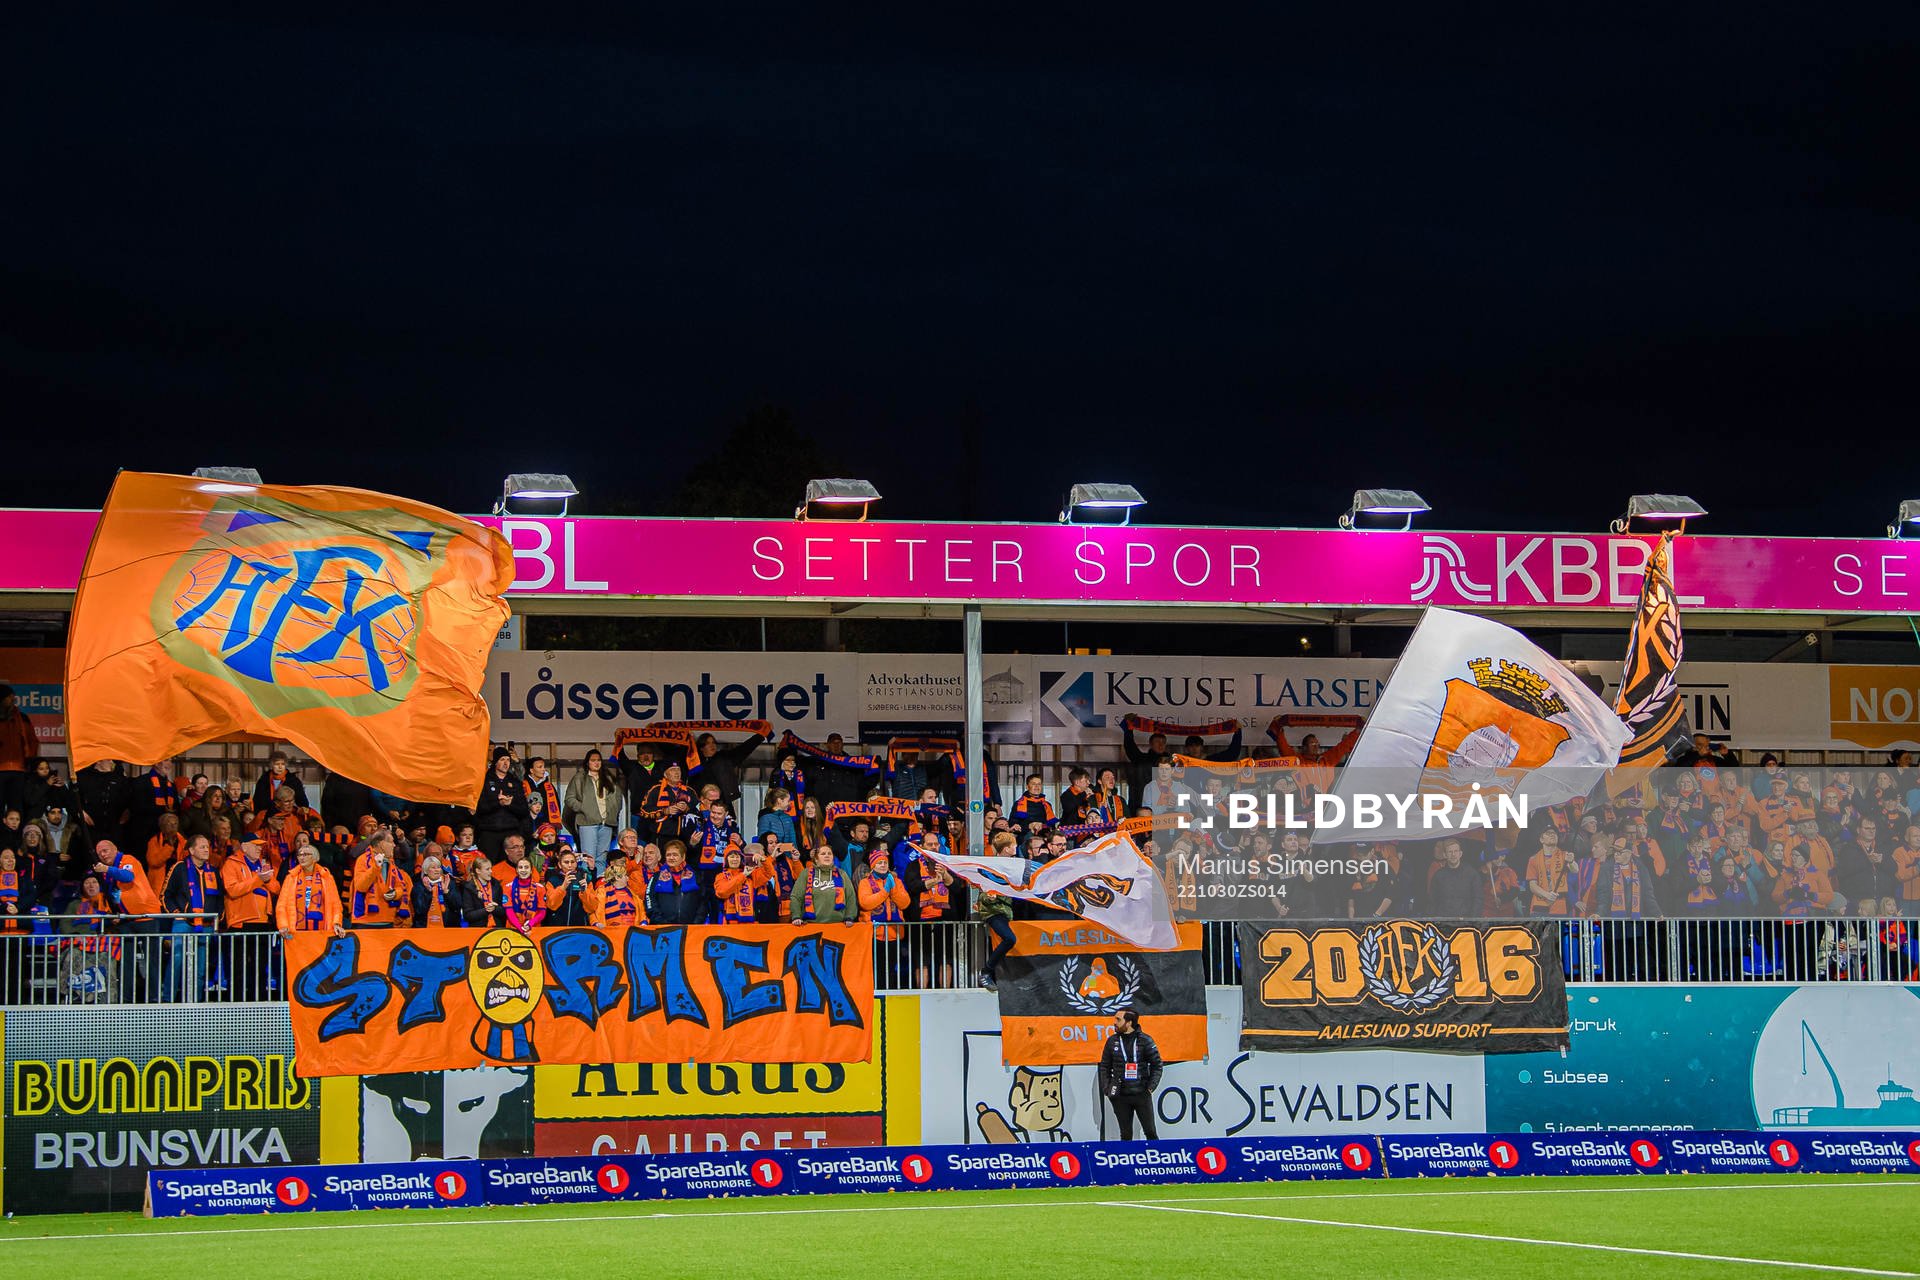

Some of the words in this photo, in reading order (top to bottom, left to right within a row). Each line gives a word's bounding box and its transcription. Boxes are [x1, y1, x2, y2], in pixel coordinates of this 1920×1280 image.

[752, 536, 1023, 583] SETTER
[1074, 541, 1261, 588] SPOR
[1496, 537, 1705, 604] KBBL
[1834, 553, 1908, 596] SE
[867, 673, 961, 685] Advokathuset
[500, 666, 829, 721] Låssenteret
[867, 688, 962, 696] KRISTIANSUND
[1104, 671, 1236, 707] KRUSE
[904, 704, 926, 712] LEREN
[848, 755, 871, 765] Alle
[1040, 929, 1130, 946] AALESU
[1060, 1026, 1088, 1041] ON
[1318, 1024, 1410, 1040] AALESUND
[1413, 1022, 1491, 1039] SUPPORT
[13, 1054, 311, 1116] BUNNPRIS
[1544, 1070, 1609, 1084] Subsea
[1157, 1086, 1213, 1125] OR
[1225, 1052, 1453, 1136] SEVALDSEN
[34, 1127, 292, 1169] BRUNSVIKA
[1240, 1144, 1339, 1163] SpareBank
[1388, 1141, 1486, 1160] SpareBank
[1531, 1141, 1628, 1159] SpareBank
[1672, 1140, 1768, 1158] SpareBank
[1811, 1140, 1906, 1157] SpareBank
[797, 1154, 898, 1175] SpareBank
[947, 1152, 1047, 1173] SpareBank
[1094, 1148, 1195, 1168] SpareBank
[1428, 1160, 1490, 1169] NORDMØRE
[1571, 1158, 1632, 1167] NORDMØRE
[1711, 1157, 1771, 1166] NORDMØRE
[1850, 1157, 1910, 1166] NORDMØRE
[645, 1160, 749, 1182] SpareBank
[988, 1170, 1051, 1180] NORDMØRE
[1134, 1166, 1197, 1176] NORDMØRE
[1280, 1162, 1343, 1172] NORDMØRE
[325, 1173, 431, 1194] SpareBank
[488, 1166, 595, 1188] SpareBank
[686, 1179, 751, 1190] NORDMØRE
[838, 1174, 902, 1184] NORDMØRE
[166, 1179, 273, 1199] SpareBank
[367, 1191, 435, 1201] NORDMØRE
[531, 1185, 597, 1195] NORDMØRE
[208, 1197, 276, 1207] NORDMØRE
